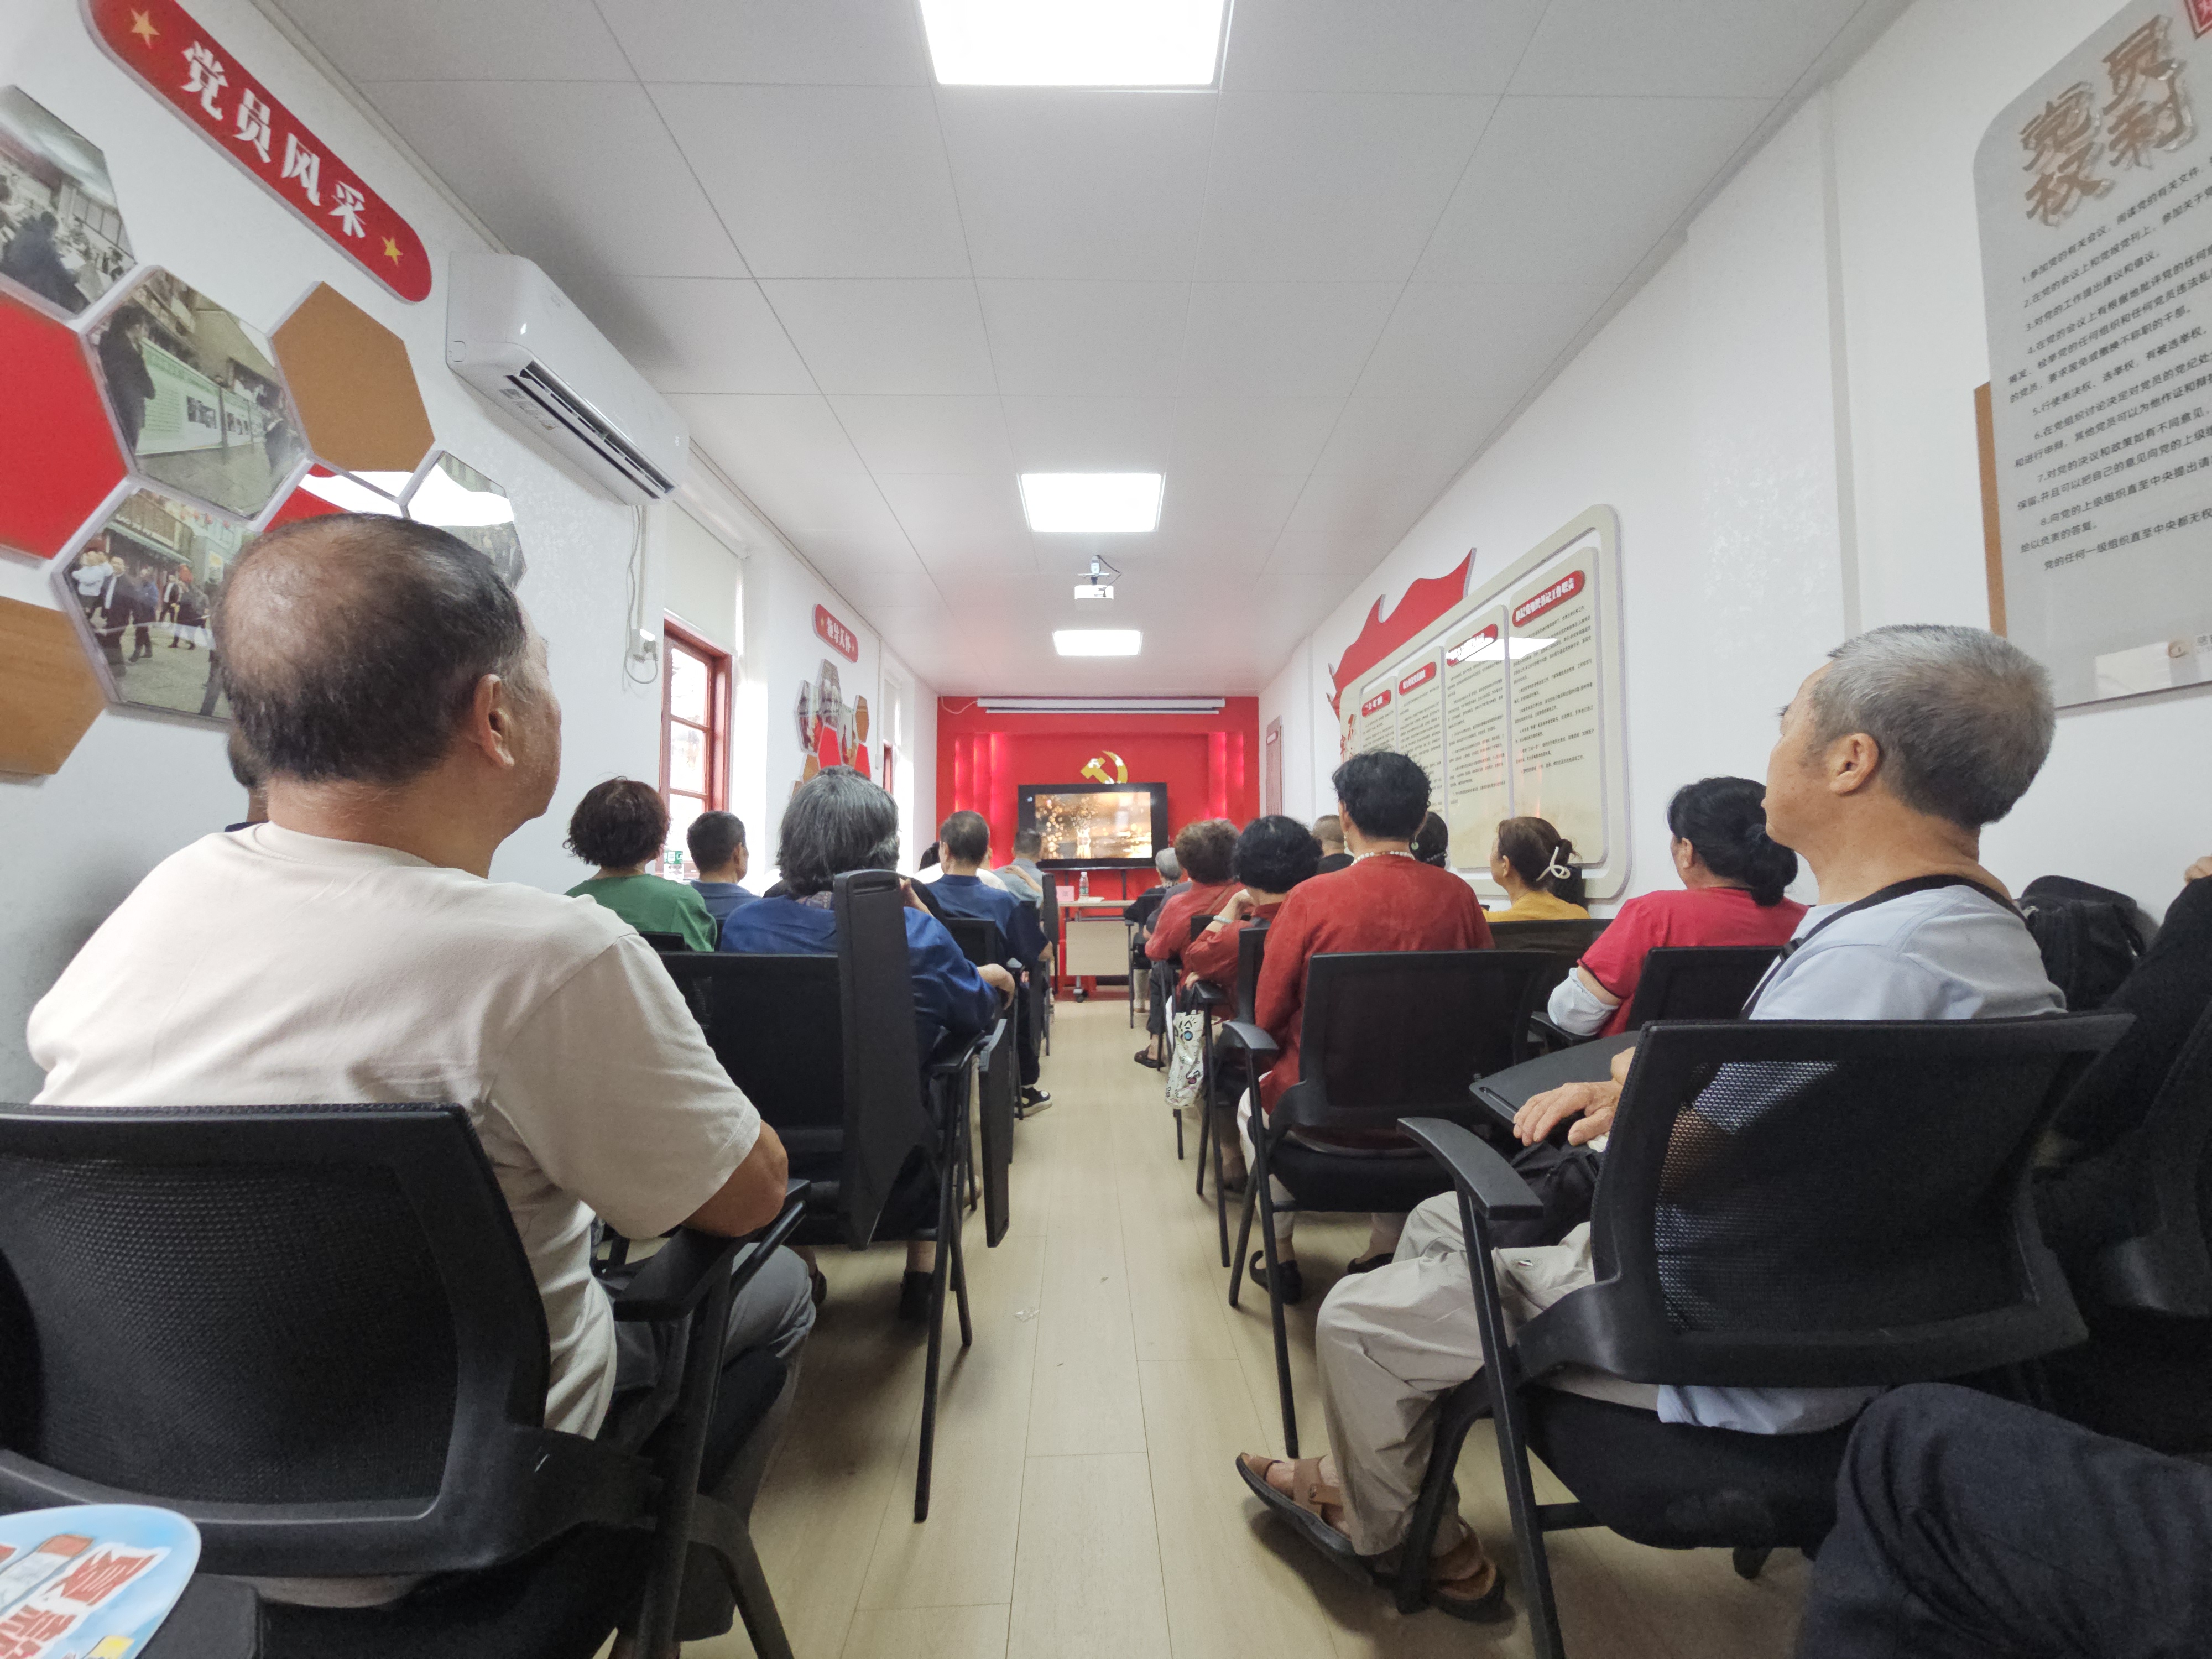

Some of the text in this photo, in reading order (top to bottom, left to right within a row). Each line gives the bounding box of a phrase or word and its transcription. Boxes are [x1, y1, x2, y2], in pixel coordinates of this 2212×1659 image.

[181, 40, 366, 238] 党员风采
[2041, 455, 2212, 526] 8.向党的上级组织直至中央提出请
